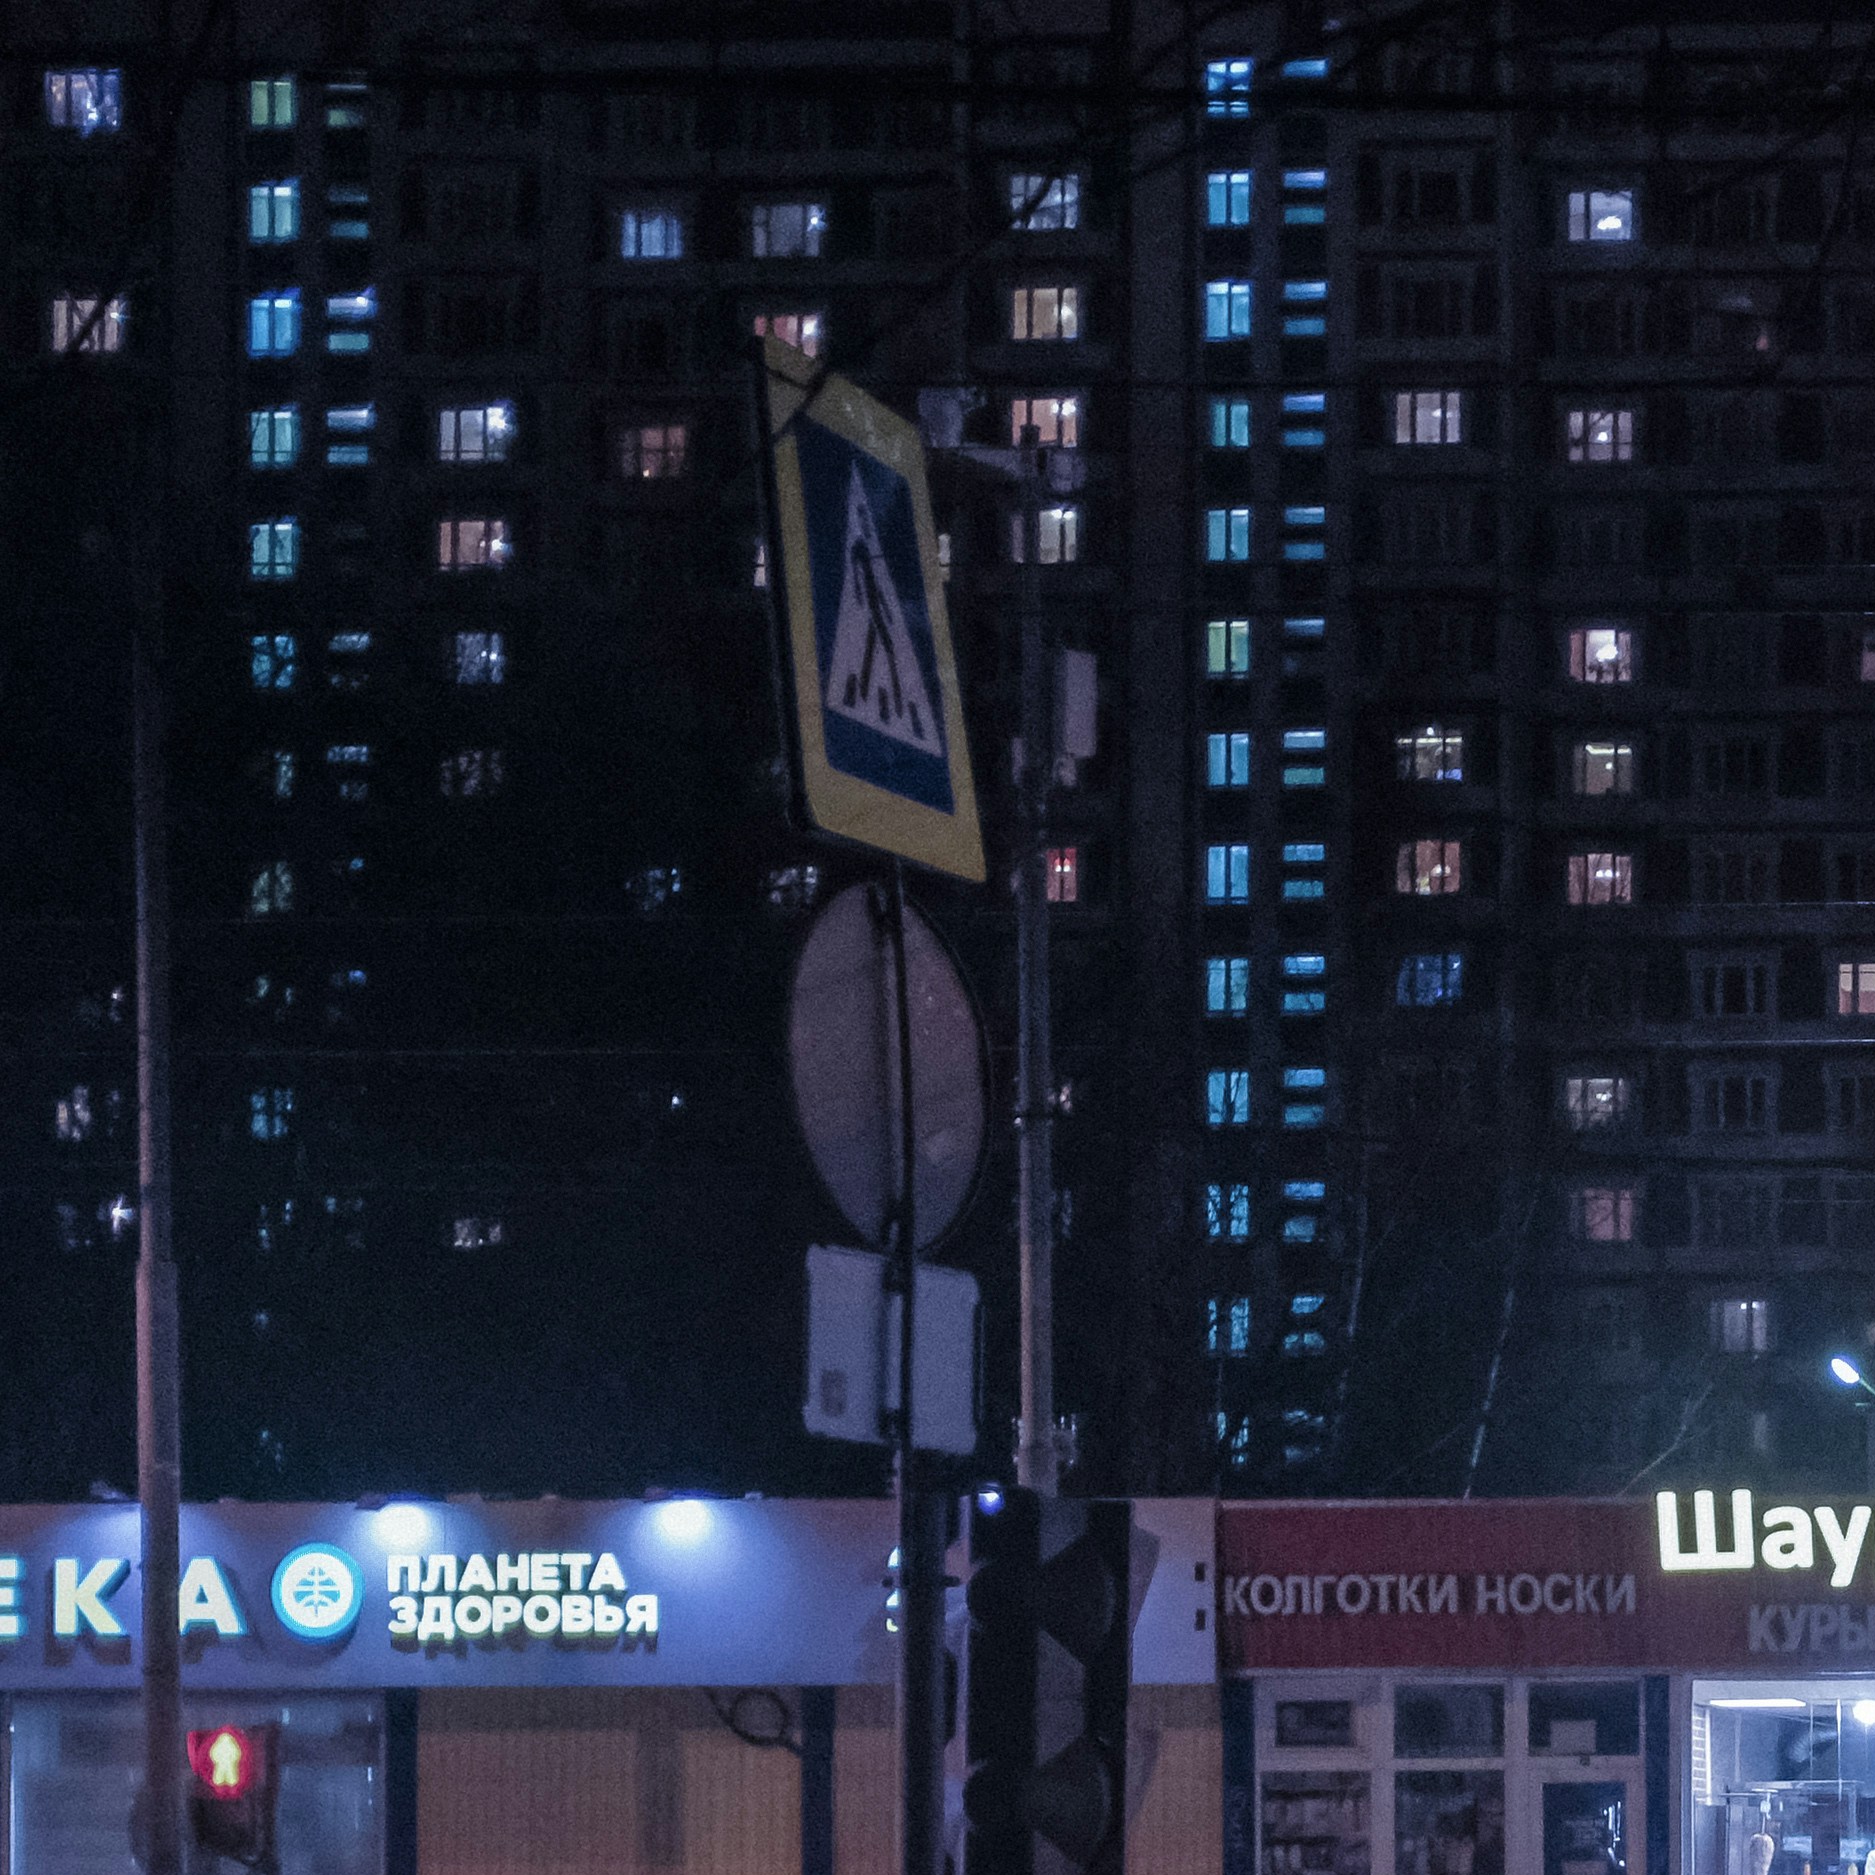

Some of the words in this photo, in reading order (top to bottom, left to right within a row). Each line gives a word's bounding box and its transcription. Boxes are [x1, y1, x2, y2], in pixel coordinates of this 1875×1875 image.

[387, 1554, 626, 1592] ПЛАНЕТА
[1223, 1574, 1458, 1617] КОЛГОТКИ
[1476, 1571, 1637, 1616] НОСКИ
[387, 1594, 660, 1641] ЗДОРОВЬЯ
